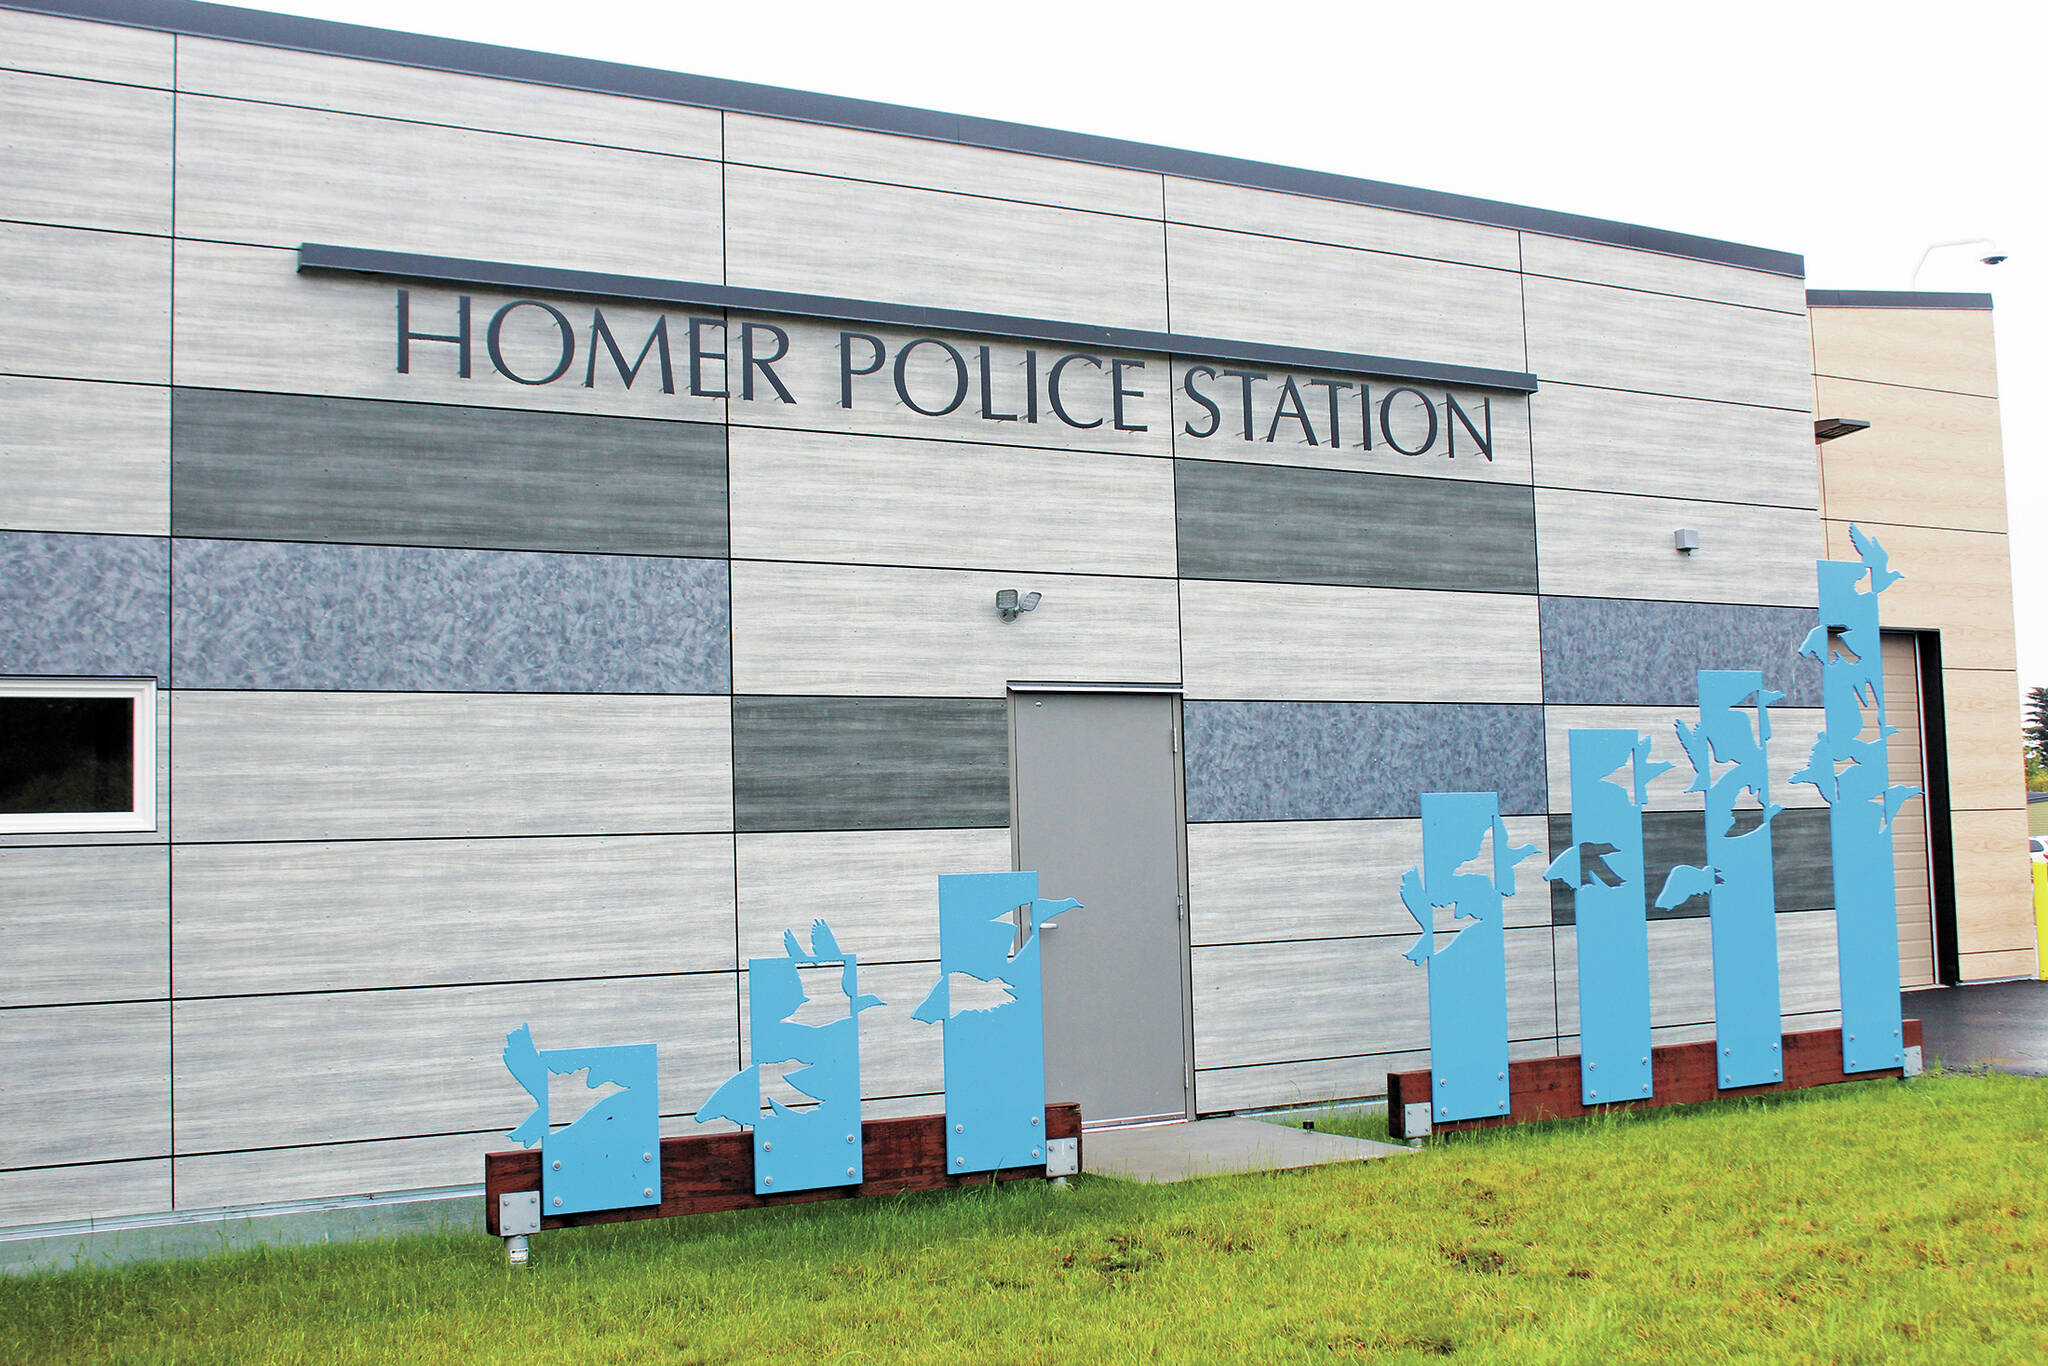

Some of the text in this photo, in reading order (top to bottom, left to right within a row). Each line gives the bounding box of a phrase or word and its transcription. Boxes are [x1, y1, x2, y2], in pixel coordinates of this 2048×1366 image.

[397, 289, 1492, 462] HOMER POLICE STATION
